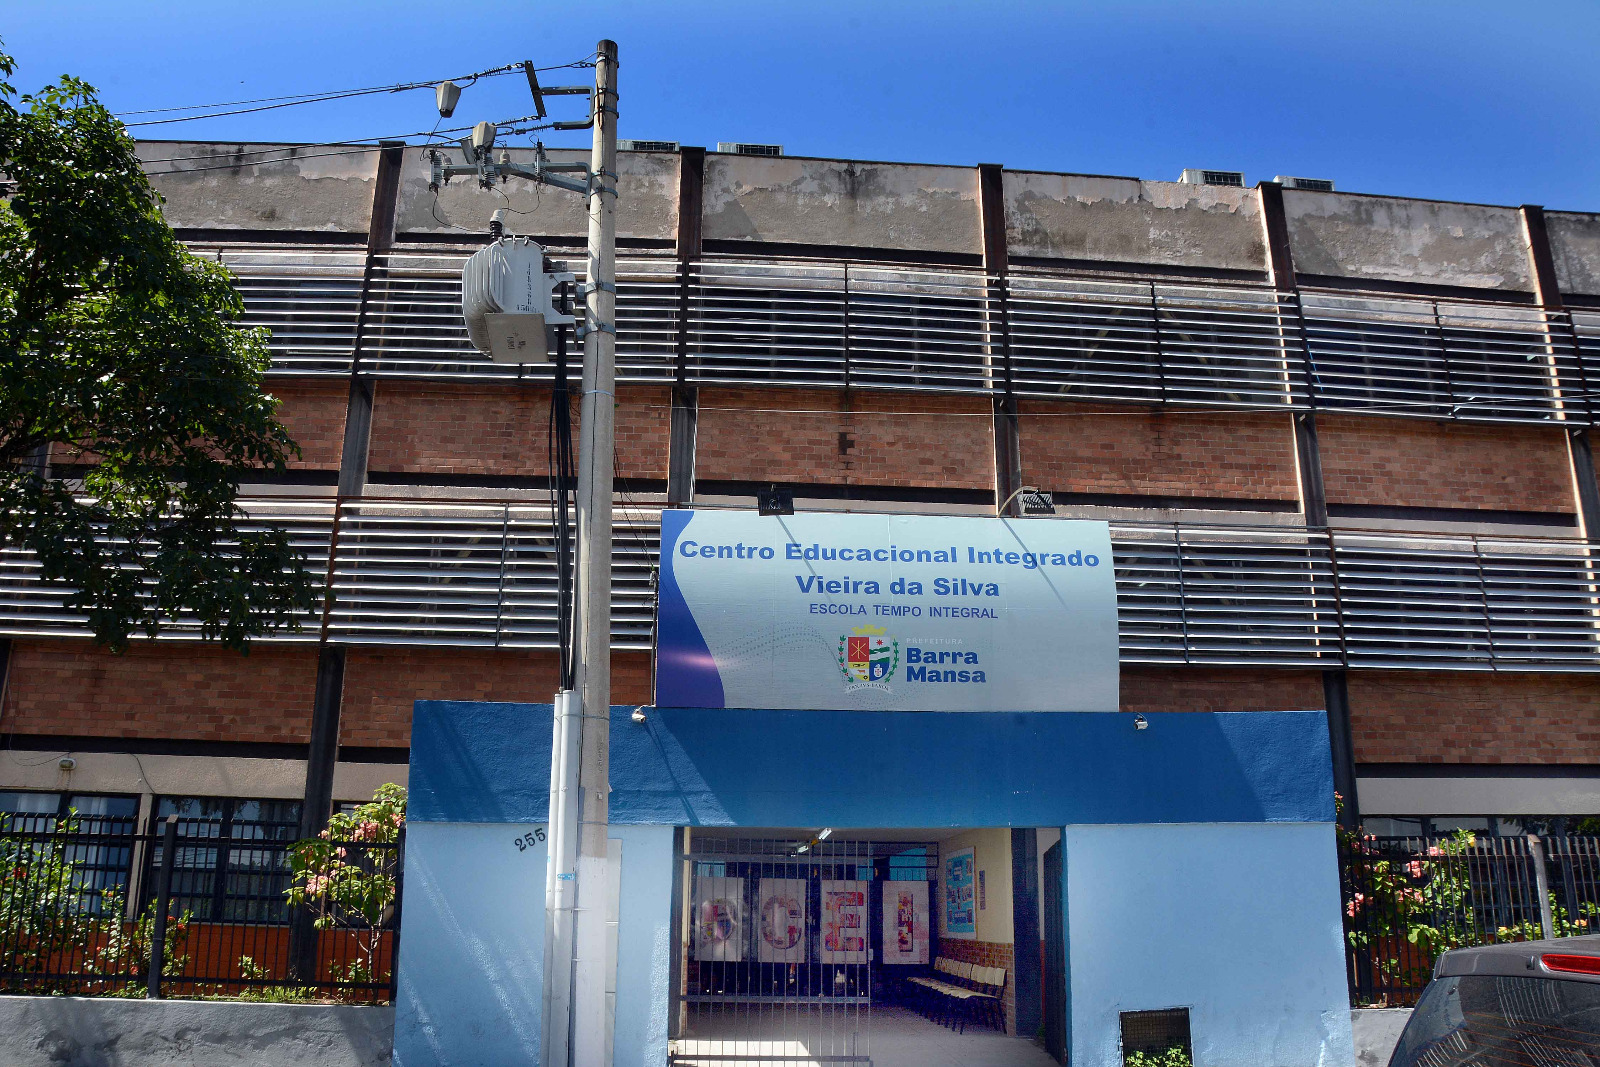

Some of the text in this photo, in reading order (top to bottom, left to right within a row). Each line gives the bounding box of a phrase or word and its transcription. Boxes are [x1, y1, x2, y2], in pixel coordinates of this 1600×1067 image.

[679, 540, 1100, 570] Centro Educacional Integrado
[795, 575, 1000, 597] Vieira da Silva
[809, 603, 998, 619] ESCOLA TEMPO INTEGRAL
[906, 637, 964, 645] PREFEITURA
[906, 647, 979, 665] Barra
[906, 665, 986, 683] Mansa
[514, 827, 546, 852] 255
